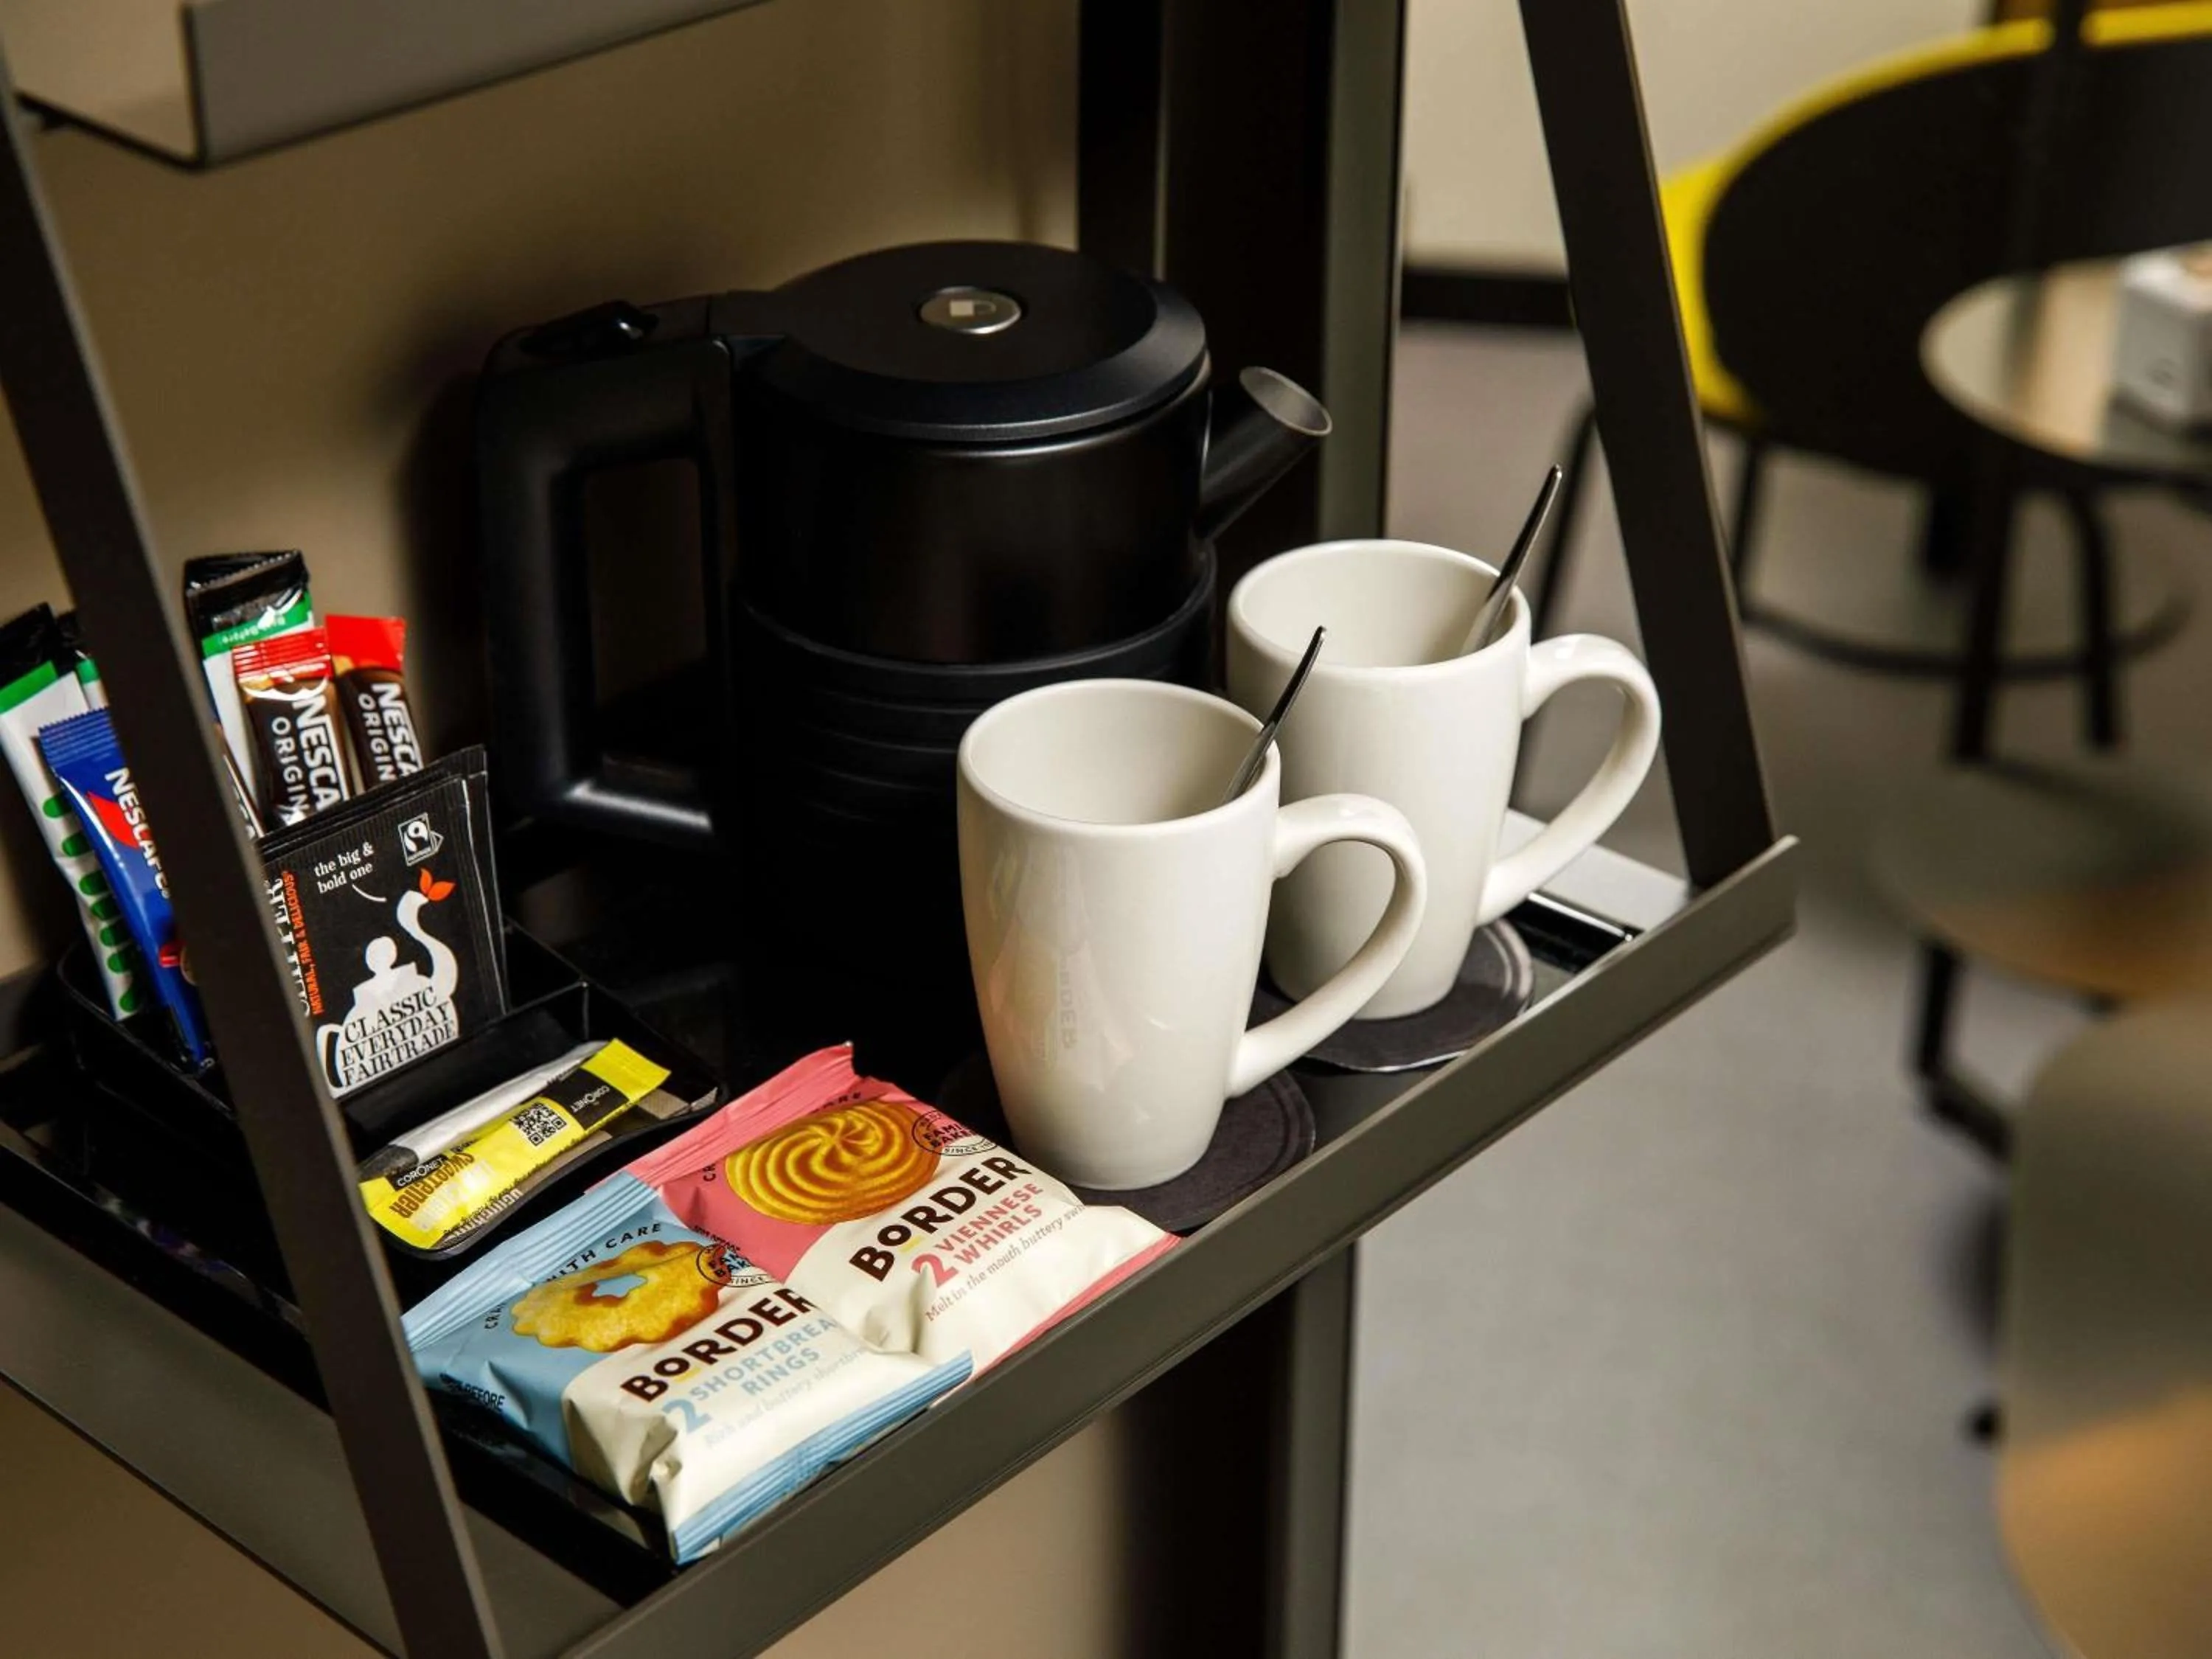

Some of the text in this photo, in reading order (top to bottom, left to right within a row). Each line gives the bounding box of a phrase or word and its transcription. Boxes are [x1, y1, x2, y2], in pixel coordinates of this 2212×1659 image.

[314, 842, 374, 877] the big &
[317, 863, 373, 894] bold one
[341, 1001, 450, 1068] EVERYDAY
[344, 987, 437, 1043] CLASSIC
[343, 1020, 456, 1086] FAIRTRADE
[570, 1085, 610, 1113] CORONET
[397, 1155, 447, 1186] CORONET
[605, 1222, 661, 1249] CARE
[849, 1156, 1032, 1282] BORDER
[911, 1183, 1043, 1288] 2 VIENNESE
[954, 1204, 1043, 1265] WHIRLS
[925, 1293, 954, 1322] Melt
[954, 1285, 967, 1301] in
[967, 1270, 987, 1291] the
[987, 1242, 1022, 1275] mouth
[1019, 1218, 1064, 1253] buttery
[620, 1288, 819, 1402] BORDER
[740, 1347, 820, 1396] RINGS
[662, 1398, 714, 1434] 2
